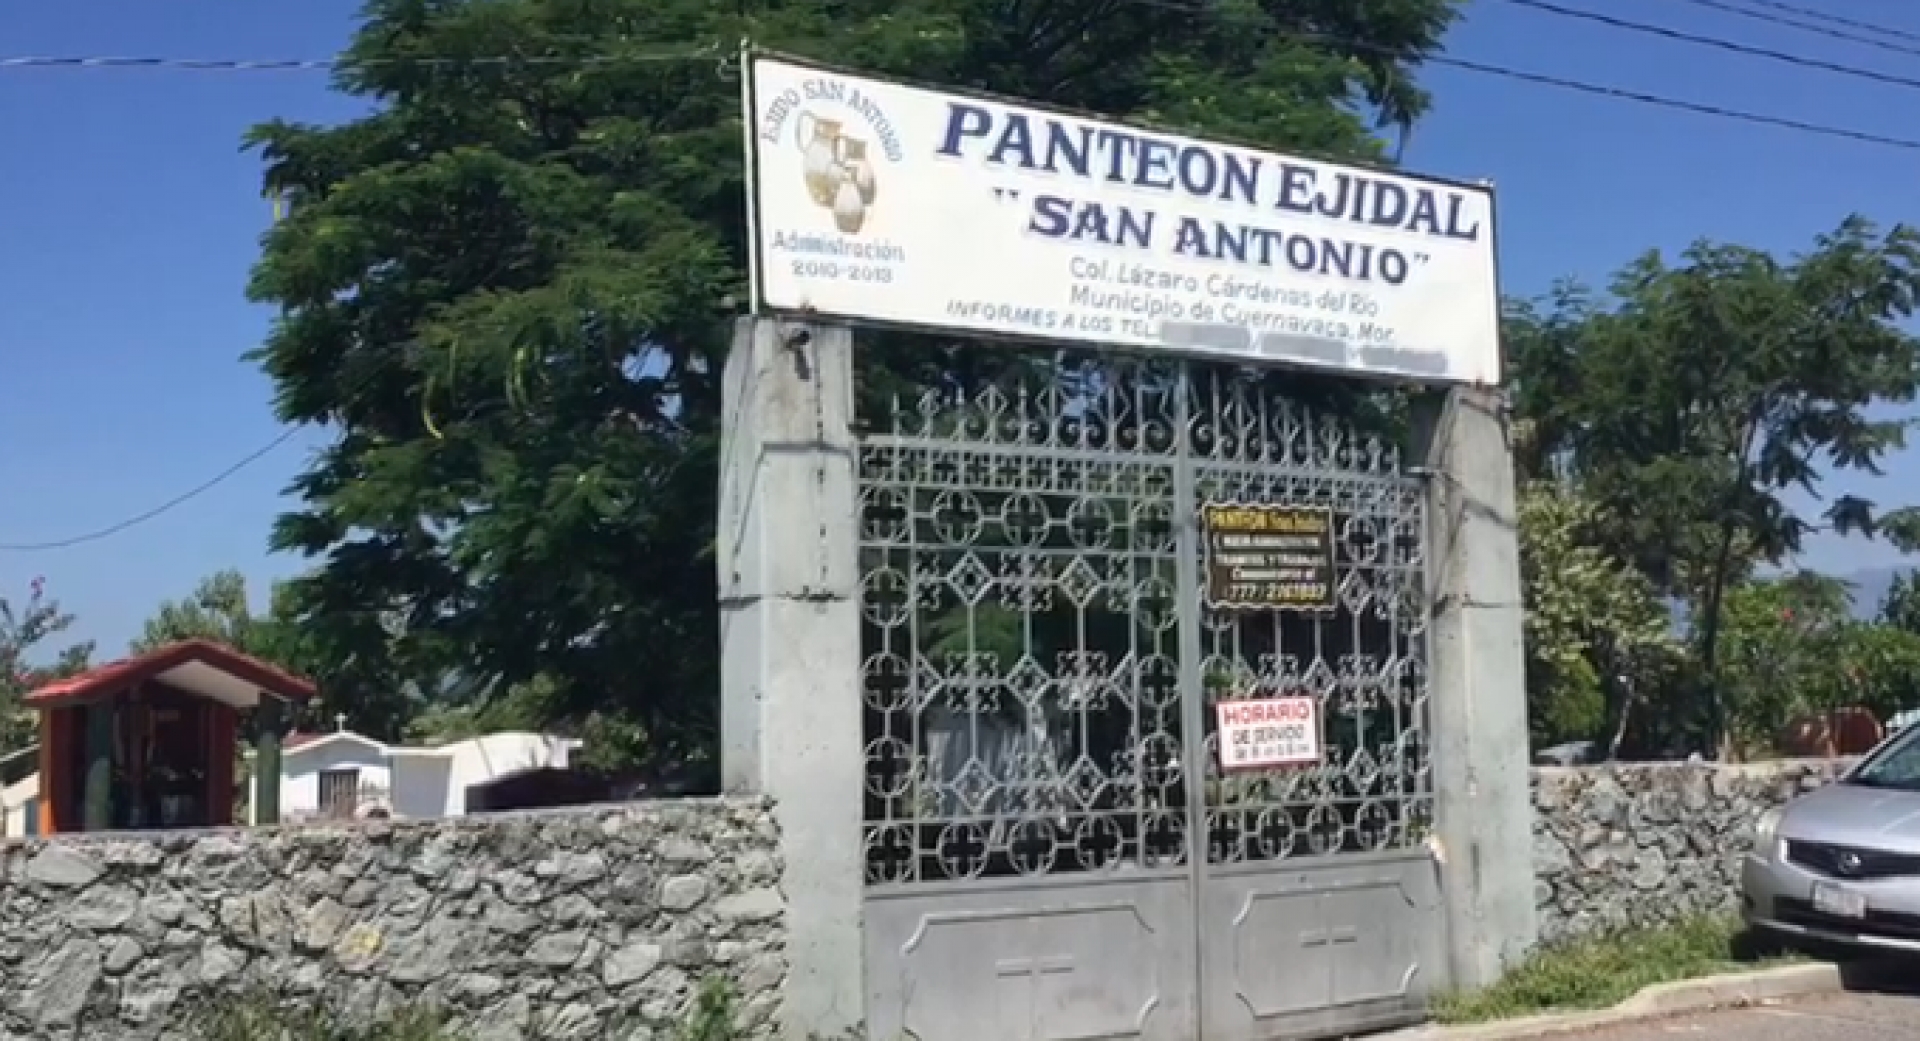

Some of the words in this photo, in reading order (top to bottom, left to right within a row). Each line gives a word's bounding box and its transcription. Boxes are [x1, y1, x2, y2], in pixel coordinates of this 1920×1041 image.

[803, 79, 845, 101] SAN
[936, 103, 1262, 205] PANTEON
[1276, 162, 1479, 240] EJIDAL
[792, 259, 893, 283] 2010-2013
[1071, 256, 1113, 283] Col.
[1316, 289, 1345, 312] del
[946, 299, 1058, 328] INFORMES
[1062, 313, 1074, 327] A
[1080, 315, 1113, 332] LOS
[1190, 298, 1214, 320] de
[1223, 700, 1310, 725] HORARIO
